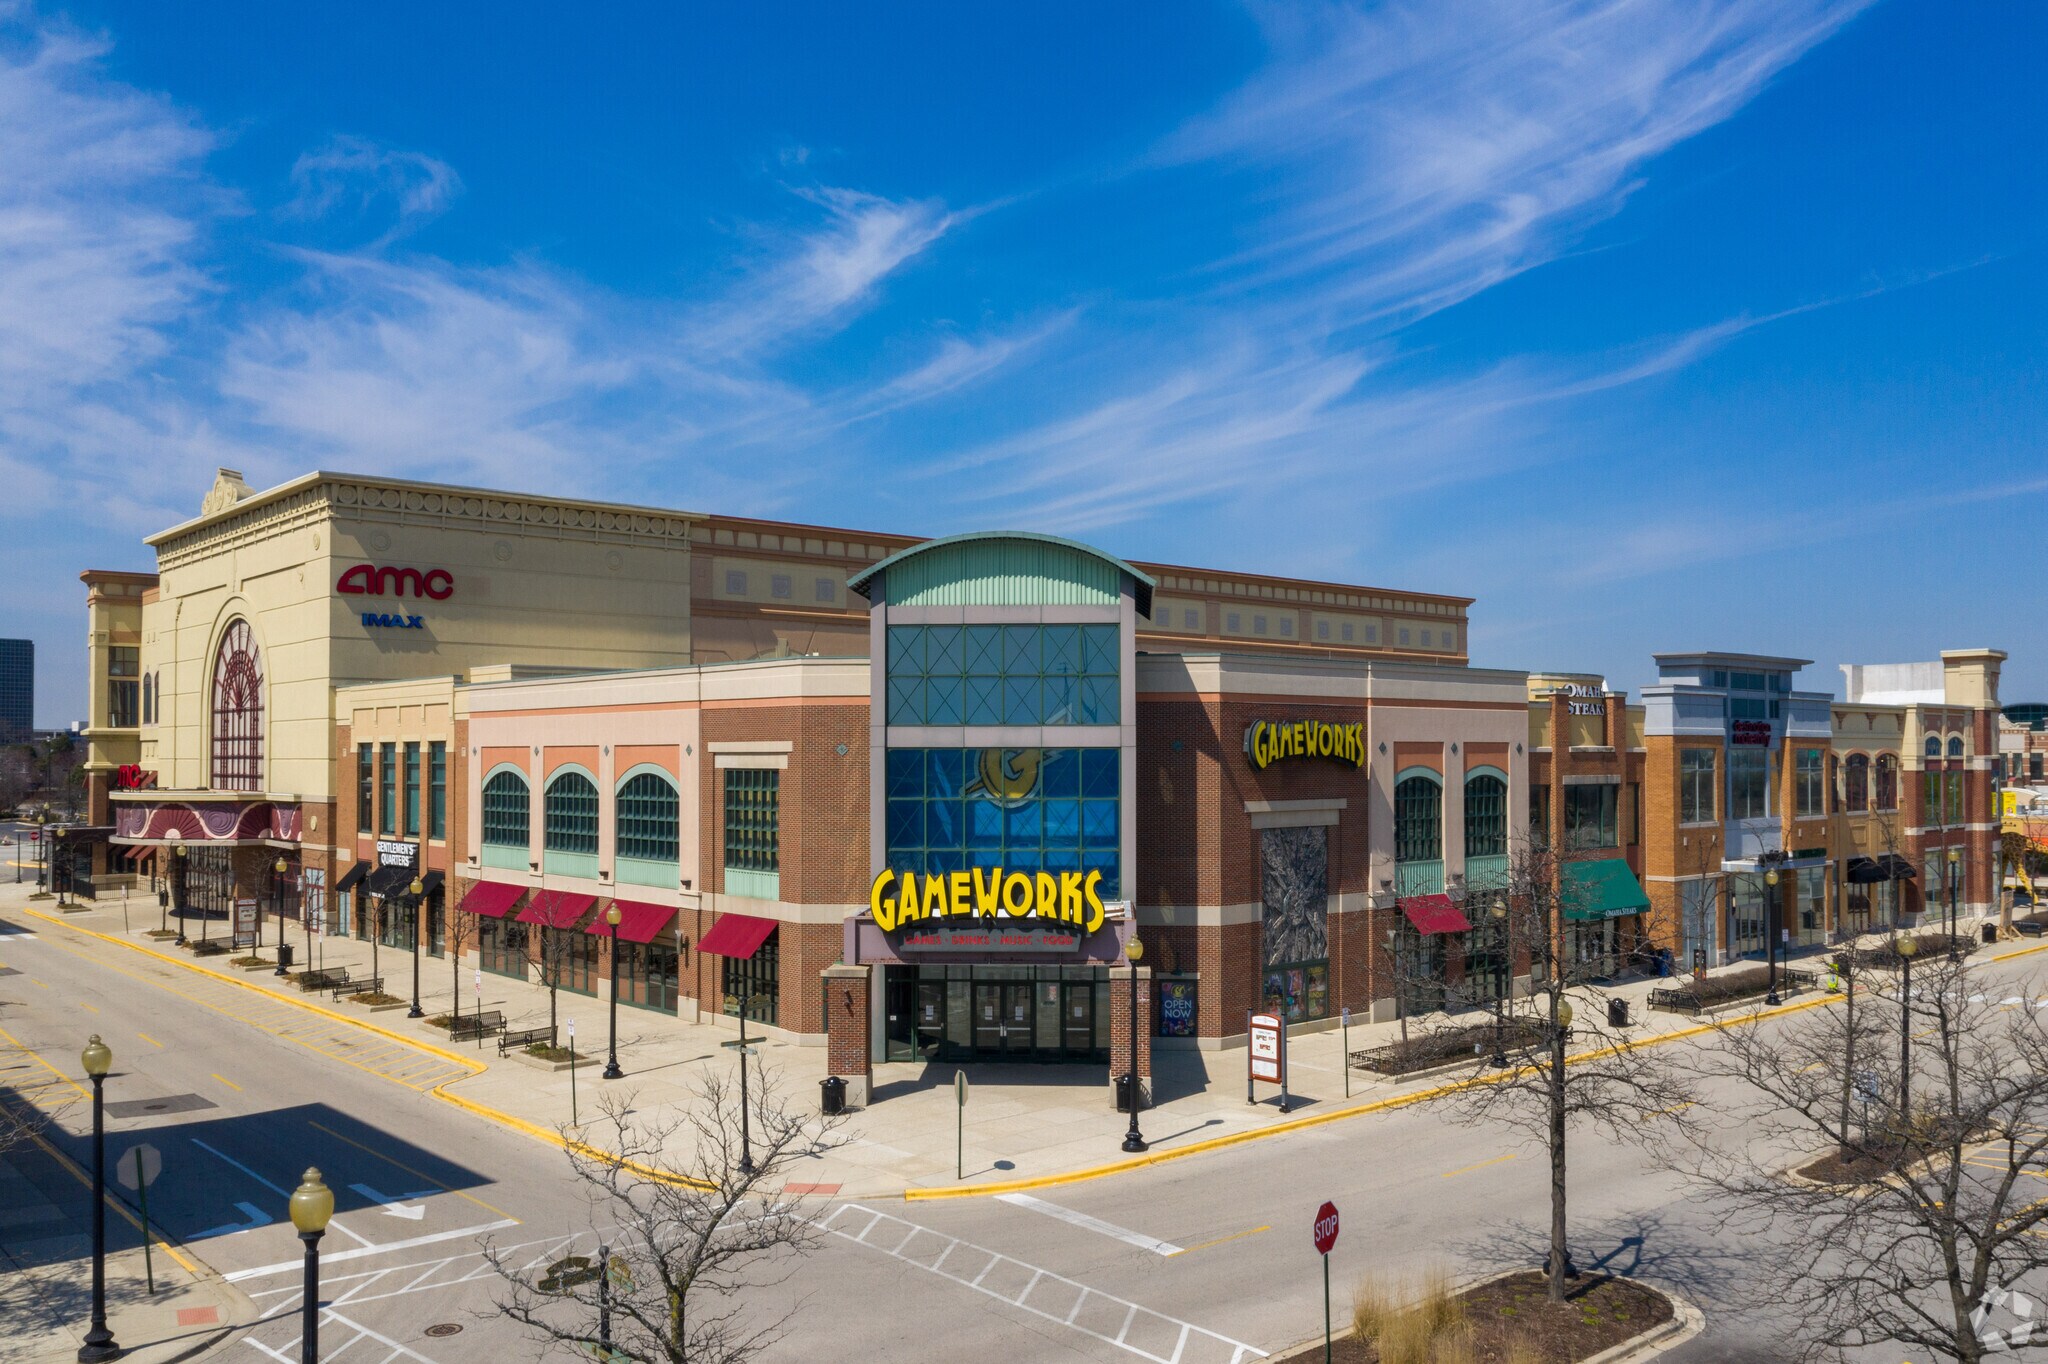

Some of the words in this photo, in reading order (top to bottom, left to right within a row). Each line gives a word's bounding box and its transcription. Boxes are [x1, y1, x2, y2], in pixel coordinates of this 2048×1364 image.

[361, 612, 423, 629] IMAX
[1565, 683, 1604, 698] OMAH
[381, 853, 409, 867] QUARTERS
[905, 934, 942, 945] GAMES
[951, 934, 990, 945] DRINKS
[1000, 935, 1033, 945] MUSIC
[1043, 935, 1073, 946] FOOD
[1164, 1000, 1192, 1009] OPEN
[1164, 1009, 1191, 1018] NOW
[1315, 1214, 1338, 1242] STOP
